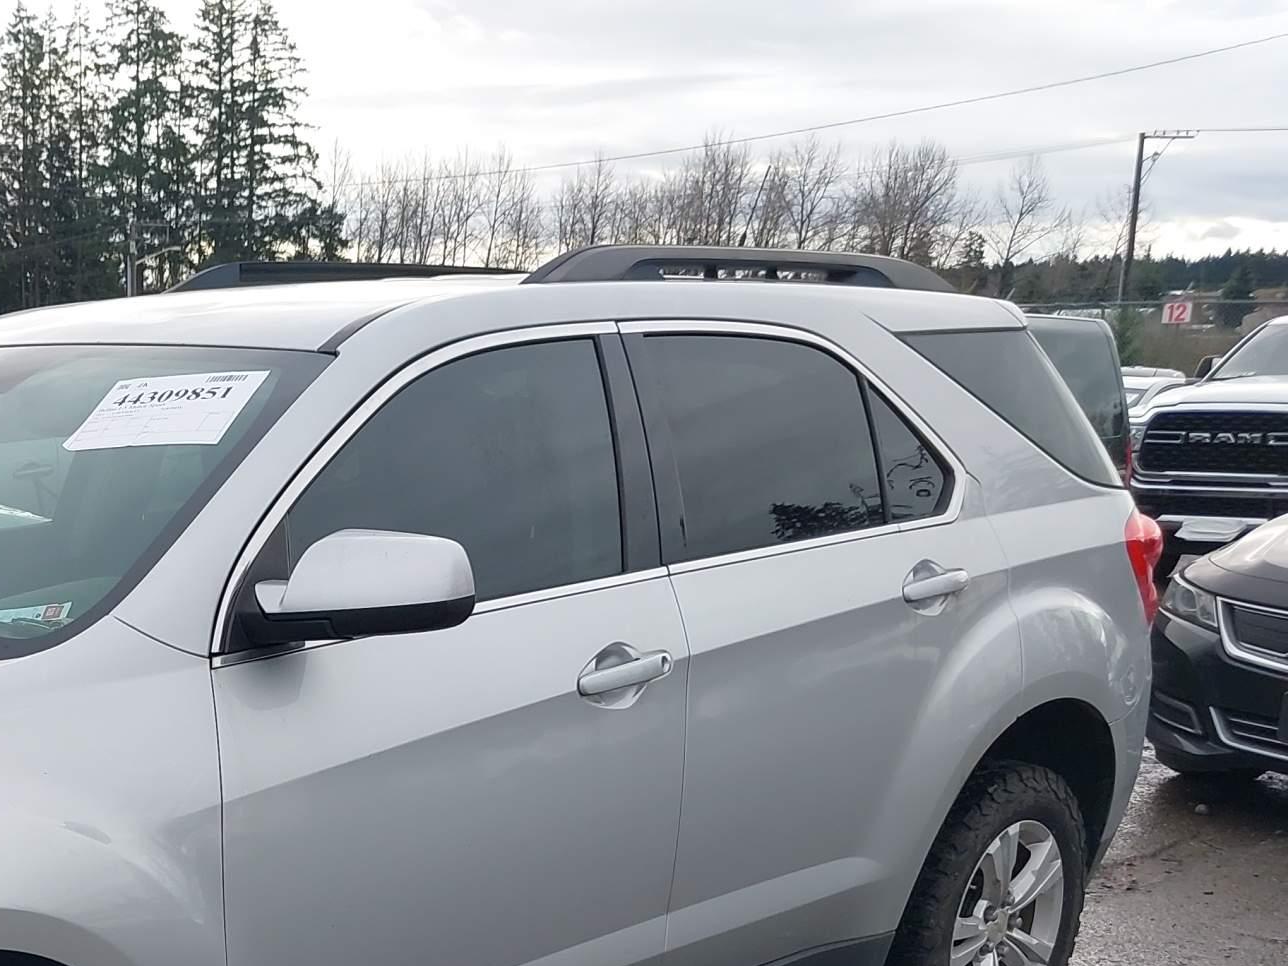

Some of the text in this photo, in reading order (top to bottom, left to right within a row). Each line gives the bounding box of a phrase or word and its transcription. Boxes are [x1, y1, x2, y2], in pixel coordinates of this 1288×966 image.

[1167, 304, 1187, 322] 12
[112, 386, 233, 407] 44309851
[1188, 432, 1263, 445] RAM
